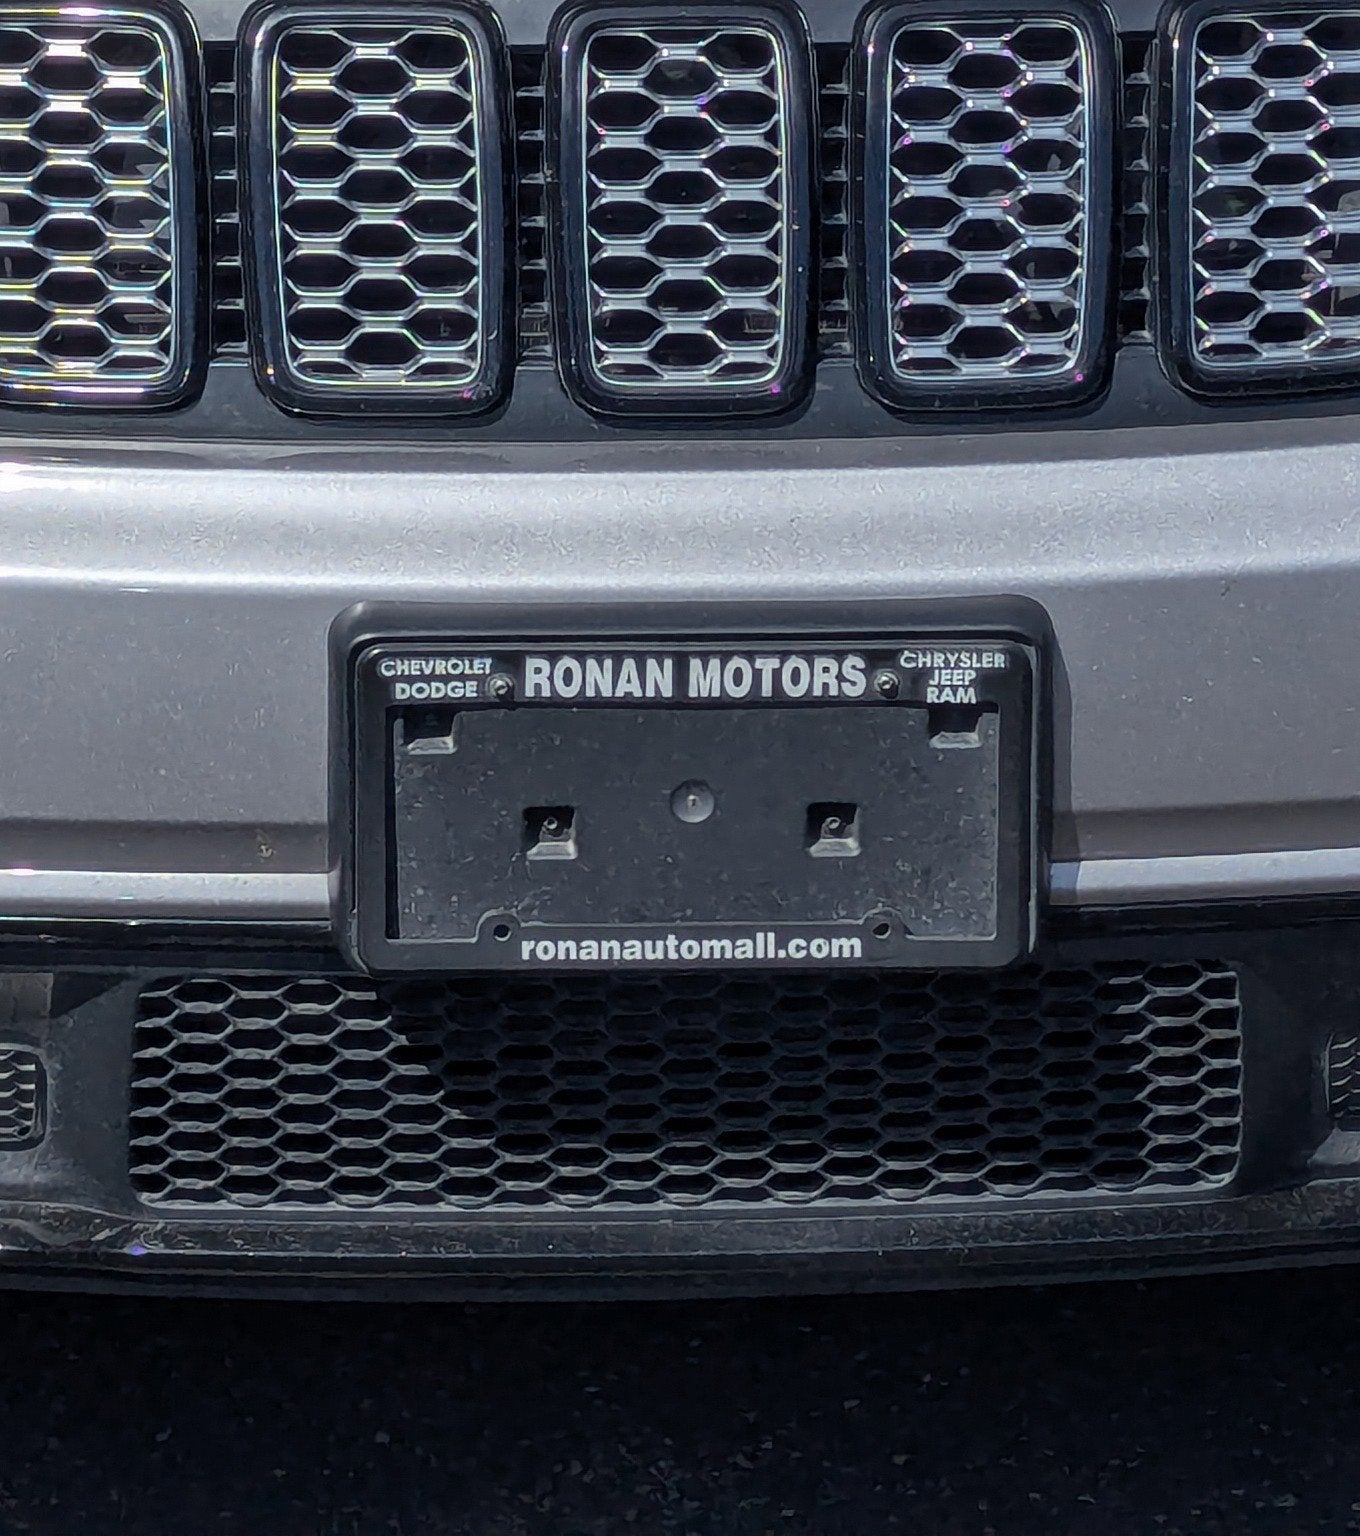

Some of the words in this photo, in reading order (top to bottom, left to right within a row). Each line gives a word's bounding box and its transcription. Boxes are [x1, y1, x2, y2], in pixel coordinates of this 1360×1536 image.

[380, 657, 492, 678] CHEVROLET
[899, 650, 1006, 669] CHRYSLER
[524, 657, 673, 698] RONAN
[688, 655, 867, 698] MOTORS
[929, 669, 977, 686] JEEP
[395, 680, 478, 700] DODGE
[926, 687, 977, 704] RAM
[521, 932, 862, 961] ronanautomall.com
